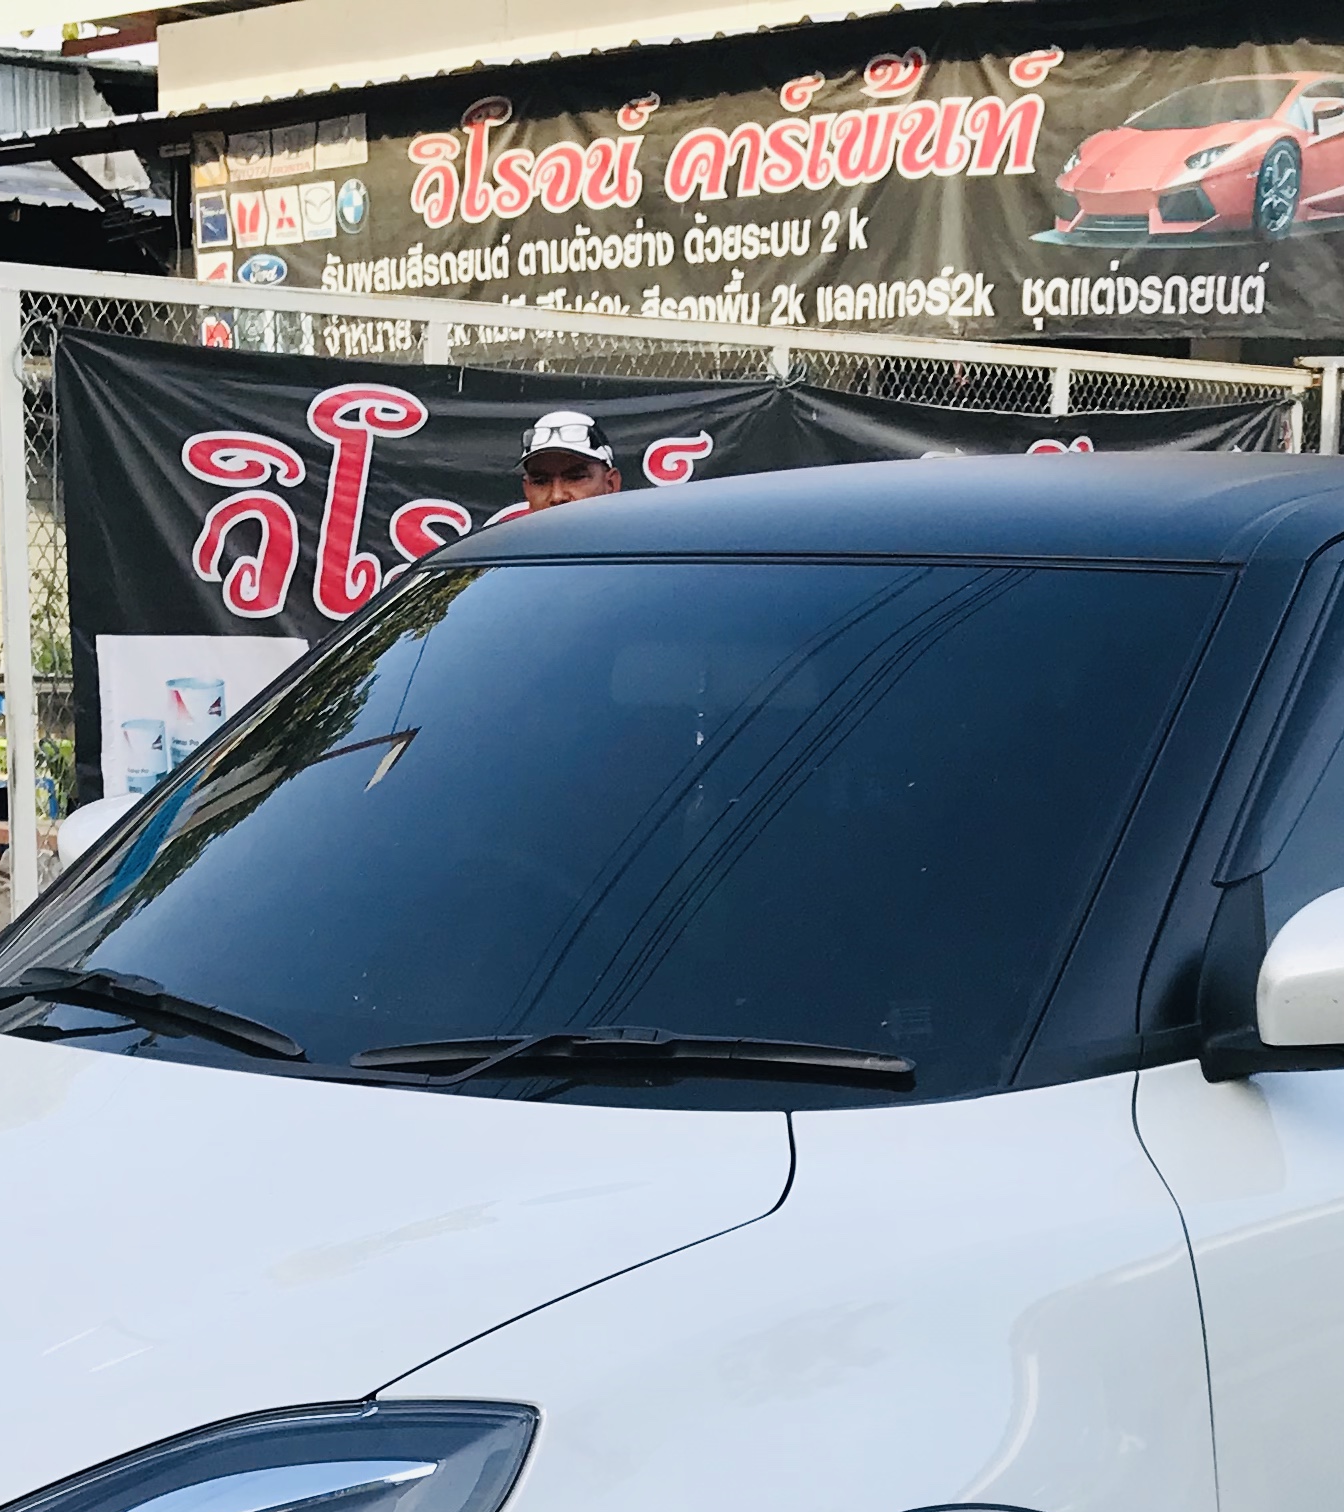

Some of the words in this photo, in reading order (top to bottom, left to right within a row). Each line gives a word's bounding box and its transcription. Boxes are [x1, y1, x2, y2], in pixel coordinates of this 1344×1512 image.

[408, 91, 660, 229] วิโรจน์
[664, 44, 1064, 203] คาร์เพ้นท์
[321, 233, 510, 293] รับผสมสีรถยนต์
[518, 217, 674, 276] ตามตัวอย่าง
[684, 211, 812, 264] ด้วยระบบ
[820, 210, 840, 254] 2
[848, 207, 869, 250] k
[770, 283, 806, 326] 2k
[1021, 259, 1270, 330] ชุดแต่งรถยนต์
